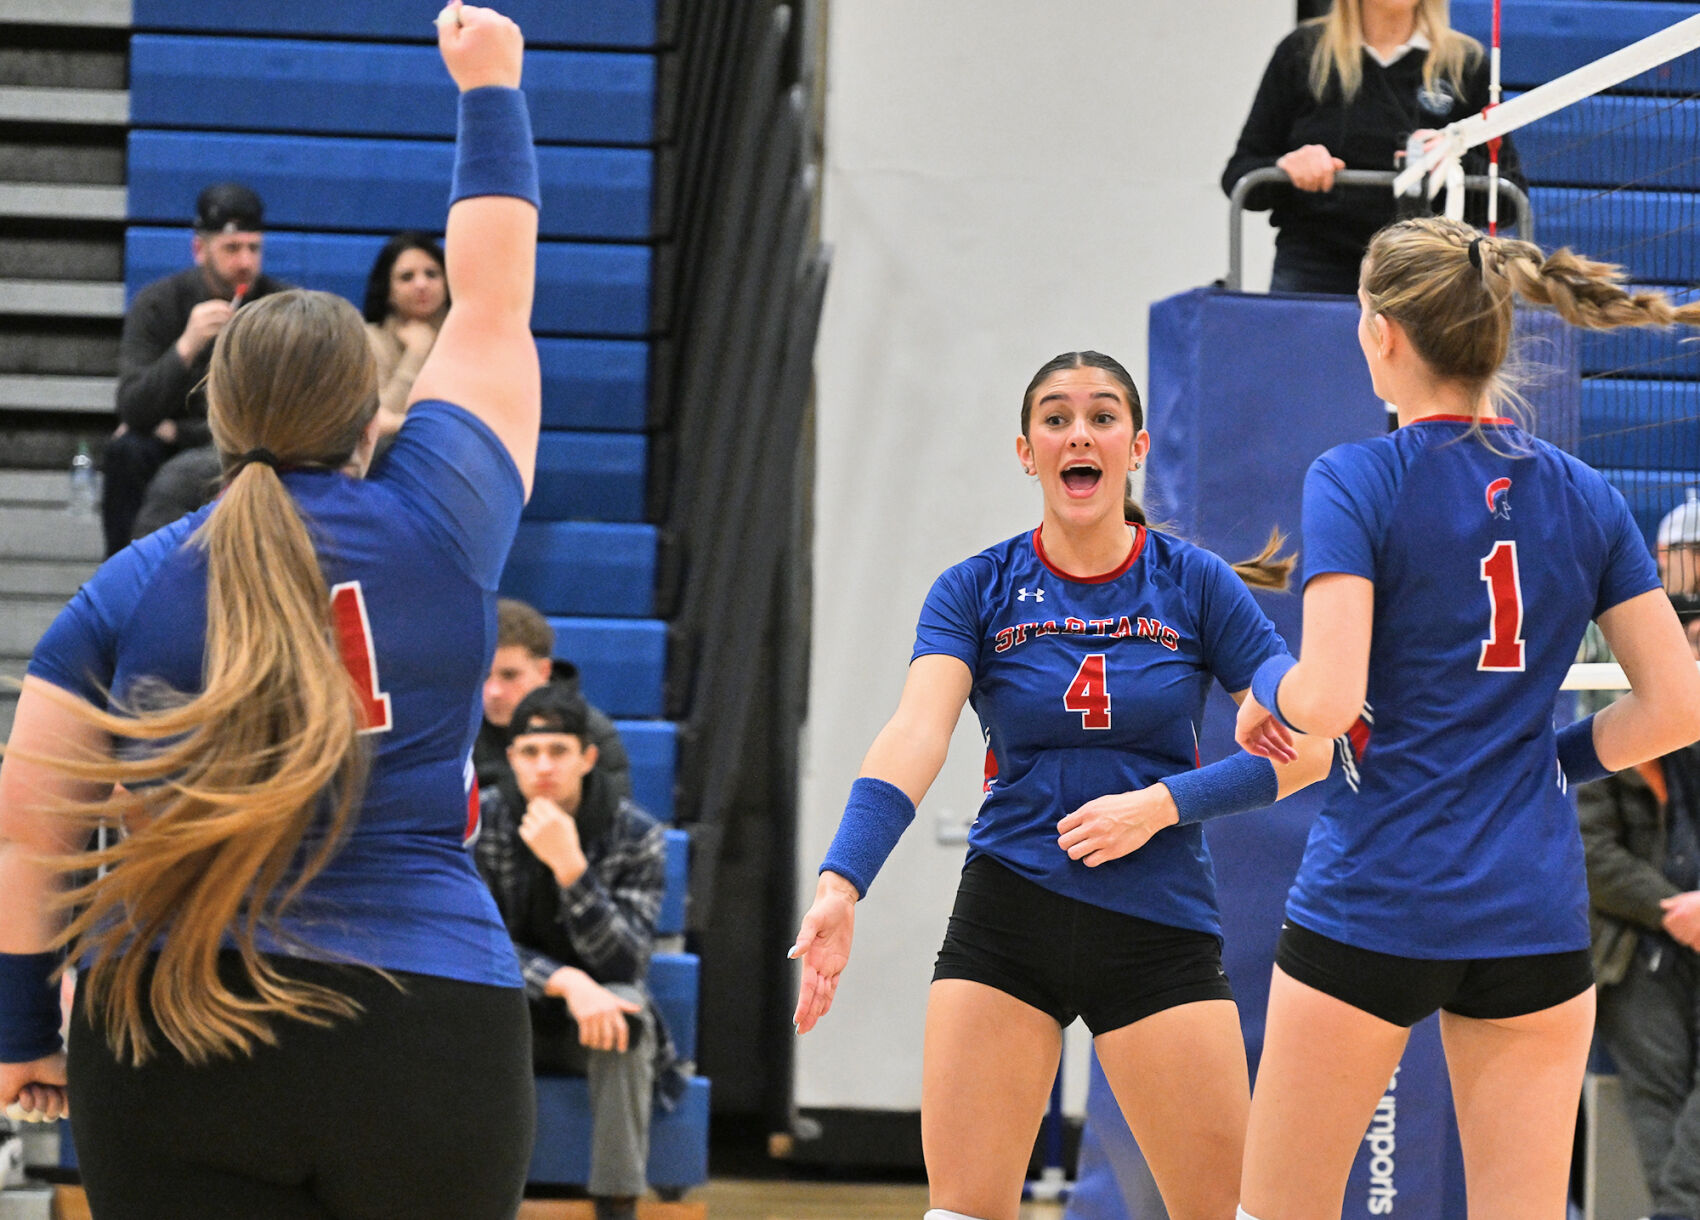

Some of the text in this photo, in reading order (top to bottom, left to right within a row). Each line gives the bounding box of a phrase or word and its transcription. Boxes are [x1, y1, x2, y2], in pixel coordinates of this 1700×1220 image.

[995, 616, 1179, 653] SPARTANS
[1477, 540, 1526, 672] 1
[1063, 654, 1111, 730] 4
